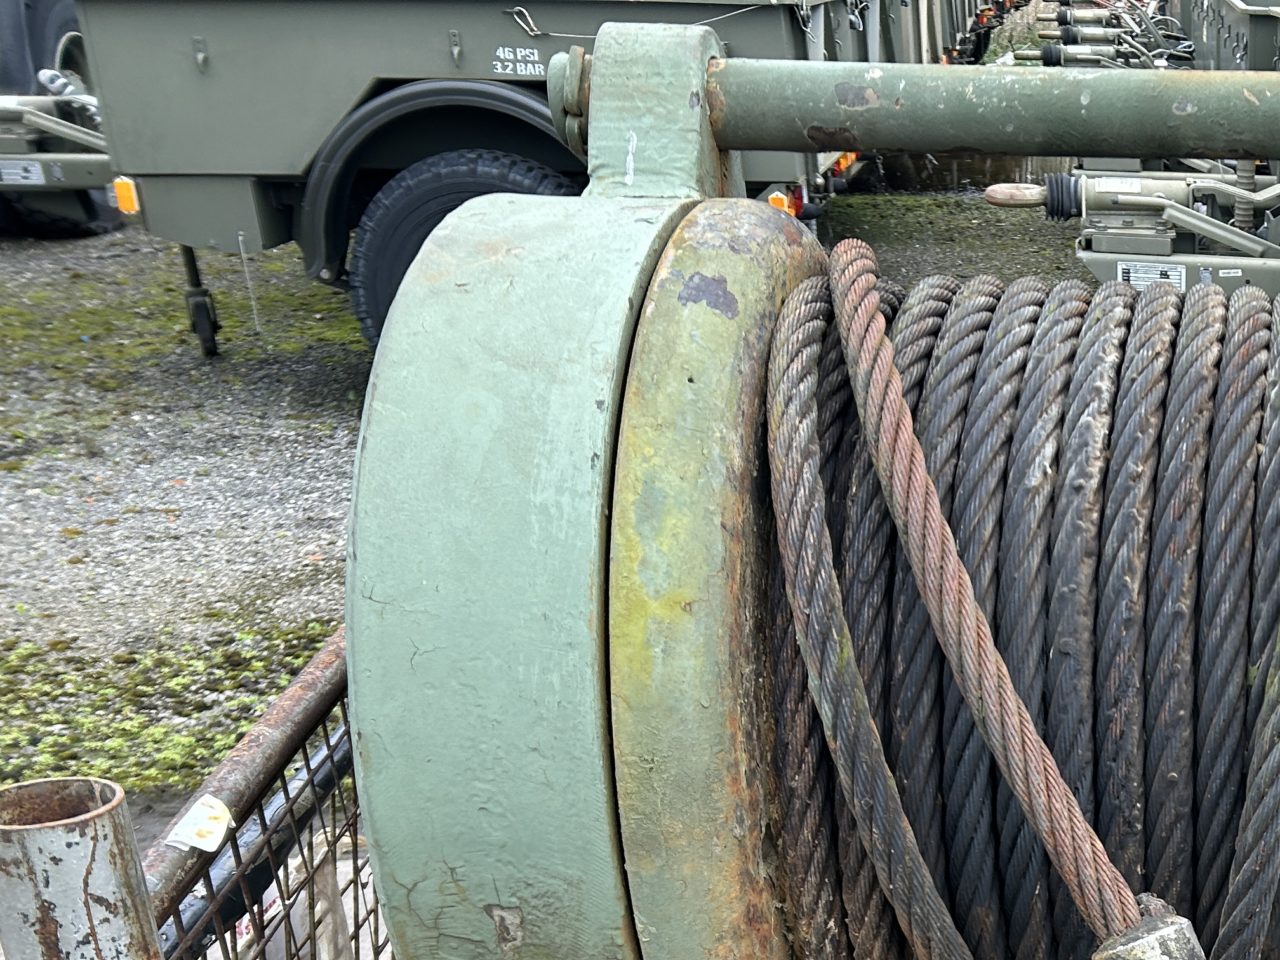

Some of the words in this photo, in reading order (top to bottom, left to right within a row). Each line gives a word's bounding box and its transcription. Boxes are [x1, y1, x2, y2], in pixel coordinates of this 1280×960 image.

[496, 46, 514, 60] 46
[516, 47, 539, 61] PSI
[492, 61, 514, 74] 3.2
[516, 62, 545, 76] BAR
